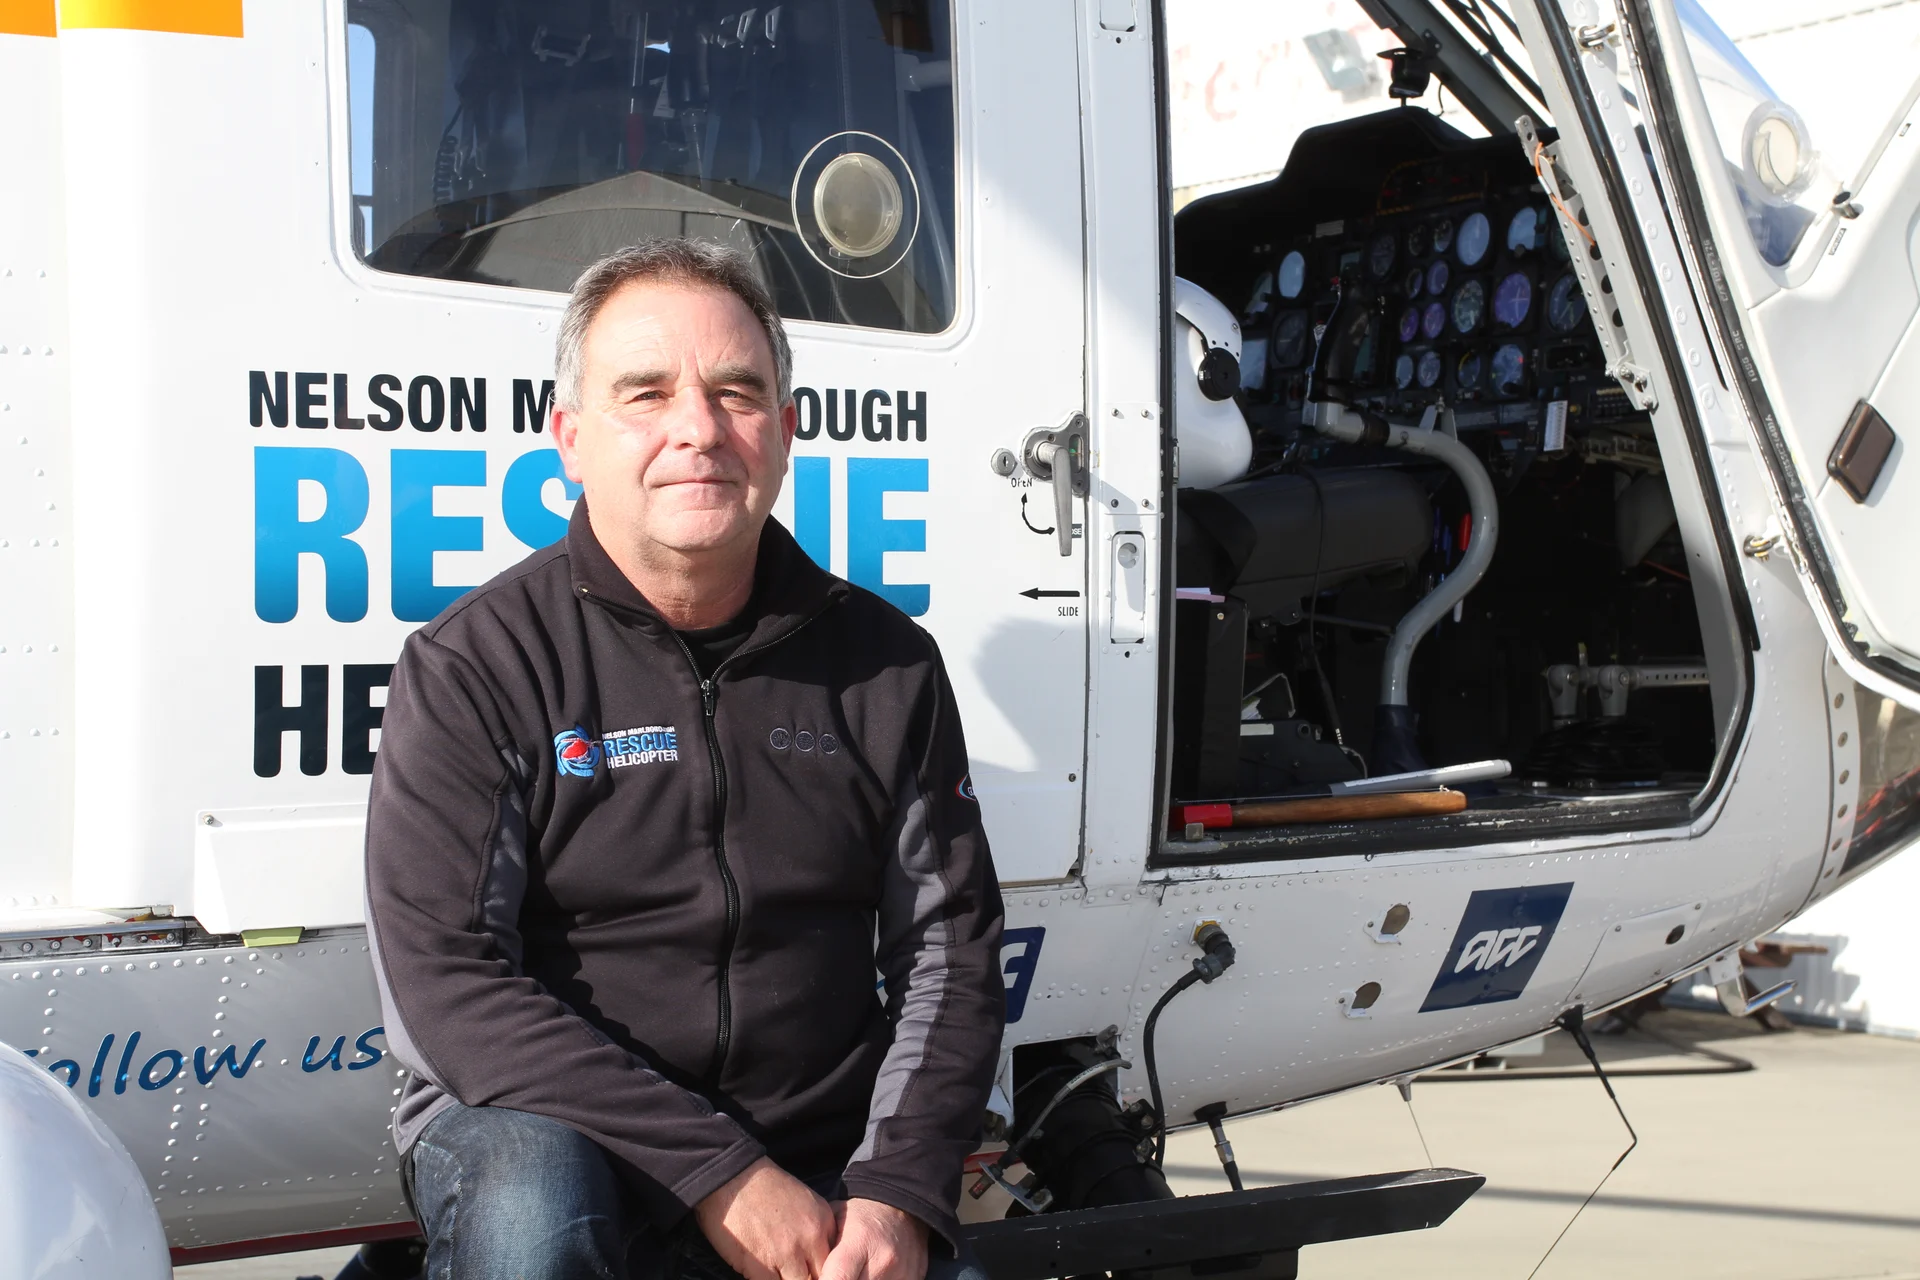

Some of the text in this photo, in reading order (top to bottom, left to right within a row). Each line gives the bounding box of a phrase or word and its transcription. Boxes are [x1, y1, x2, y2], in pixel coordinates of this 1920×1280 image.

[249, 370, 487, 432] NELSON
[1057, 606, 1079, 617] SLIDE
[602, 729, 627, 740] NELSON
[603, 732, 678, 757] RESCUE
[606, 749, 679, 769] HELICOPTER
[24, 1026, 385, 1097] ollow us
